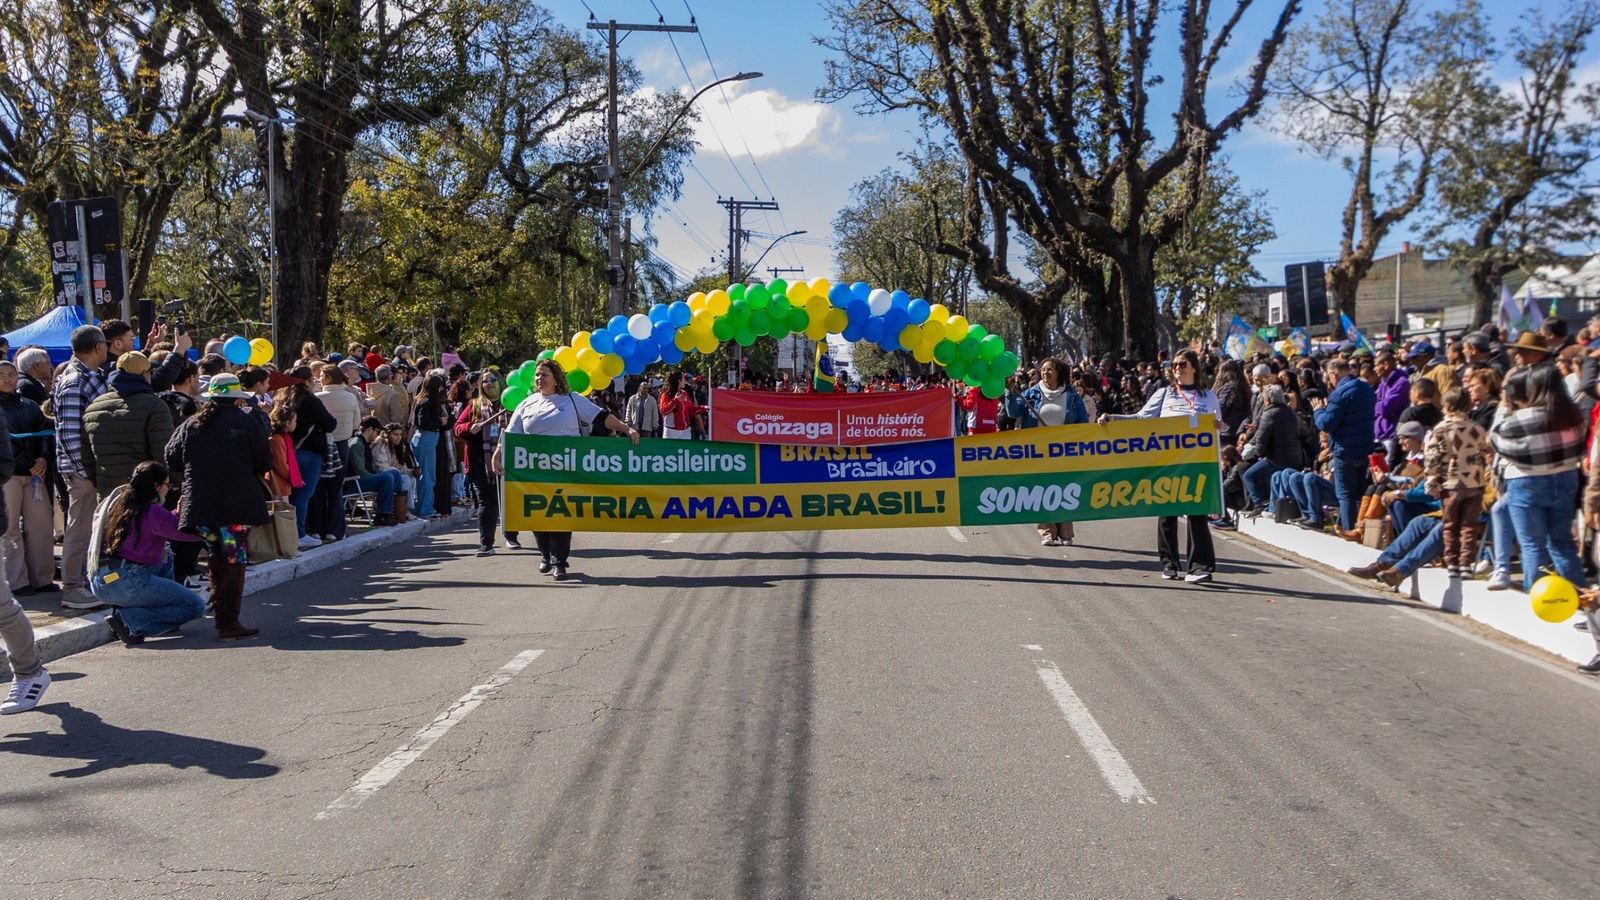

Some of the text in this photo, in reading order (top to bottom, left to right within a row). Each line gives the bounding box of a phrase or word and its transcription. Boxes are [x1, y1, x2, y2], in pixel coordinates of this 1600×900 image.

[755, 413, 784, 421] Colégio
[846, 413, 924, 425] Uma história
[737, 418, 833, 439] Gonzaga
[846, 427, 926, 437] de todos nós.
[780, 444, 872, 462] BRASIL
[961, 433, 1213, 461] BRASIL DEMOCRÁTICO
[514, 446, 747, 473] Brasil dos brasileiros
[523, 488, 946, 519] PÁTRIA AMADA BRASIL!
[977, 473, 1207, 515] SOMOS BRASIL!
